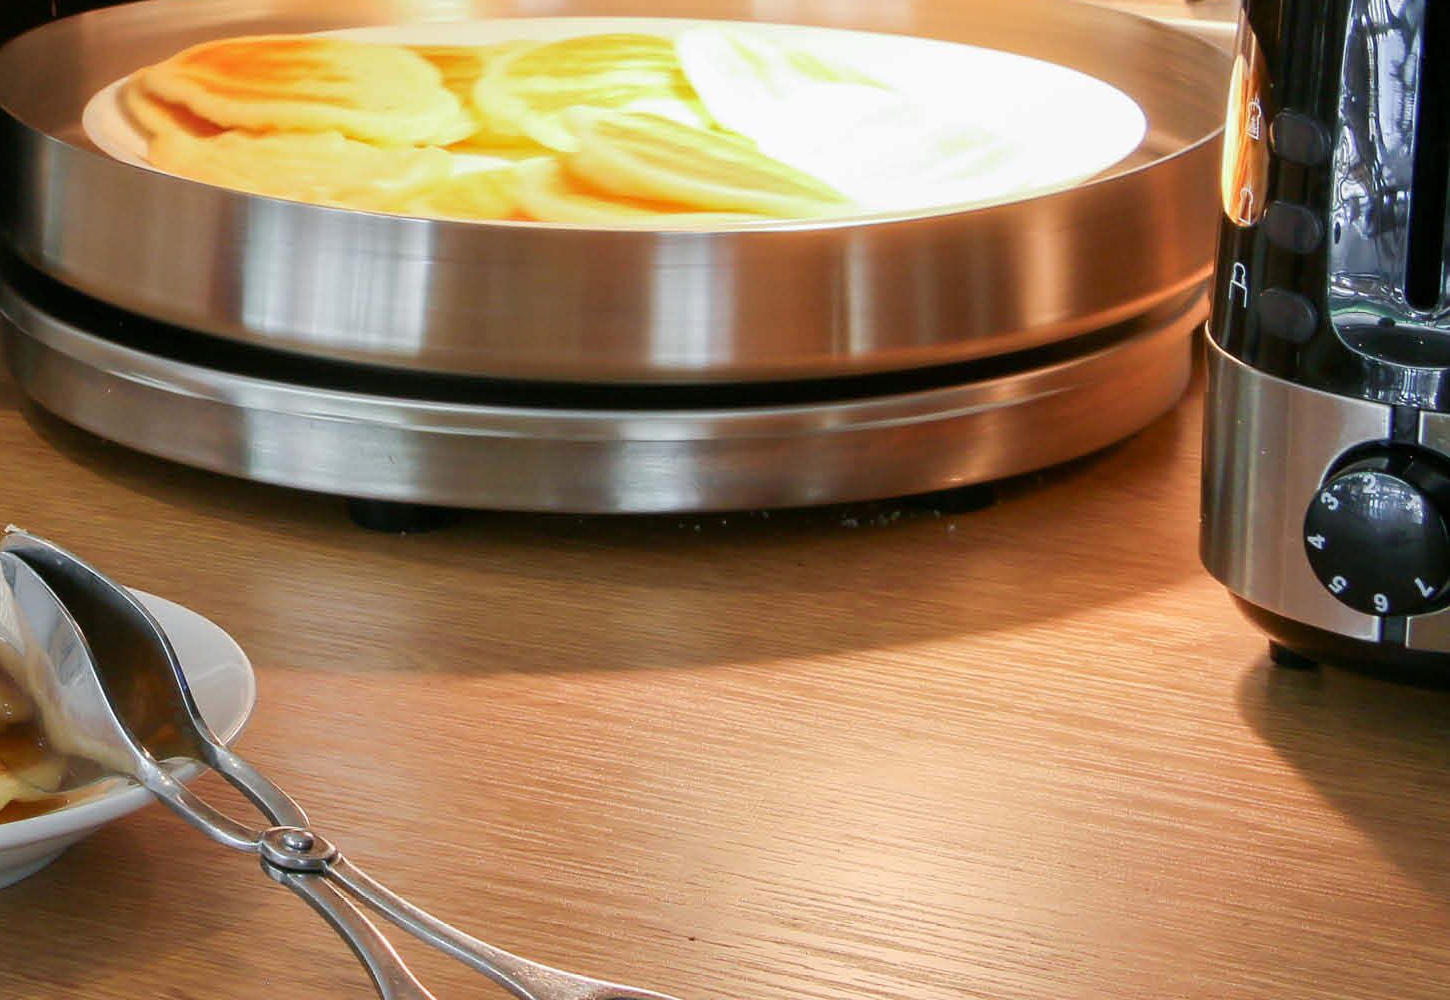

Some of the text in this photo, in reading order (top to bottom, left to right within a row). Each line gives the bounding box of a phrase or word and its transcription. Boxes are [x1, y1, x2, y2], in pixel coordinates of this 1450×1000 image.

[1362, 474, 1377, 494] 2
[1321, 491, 1339, 511] 3
[1307, 533, 1326, 550] 4
[1328, 575, 1347, 594] 5
[1414, 576, 1436, 599] 7
